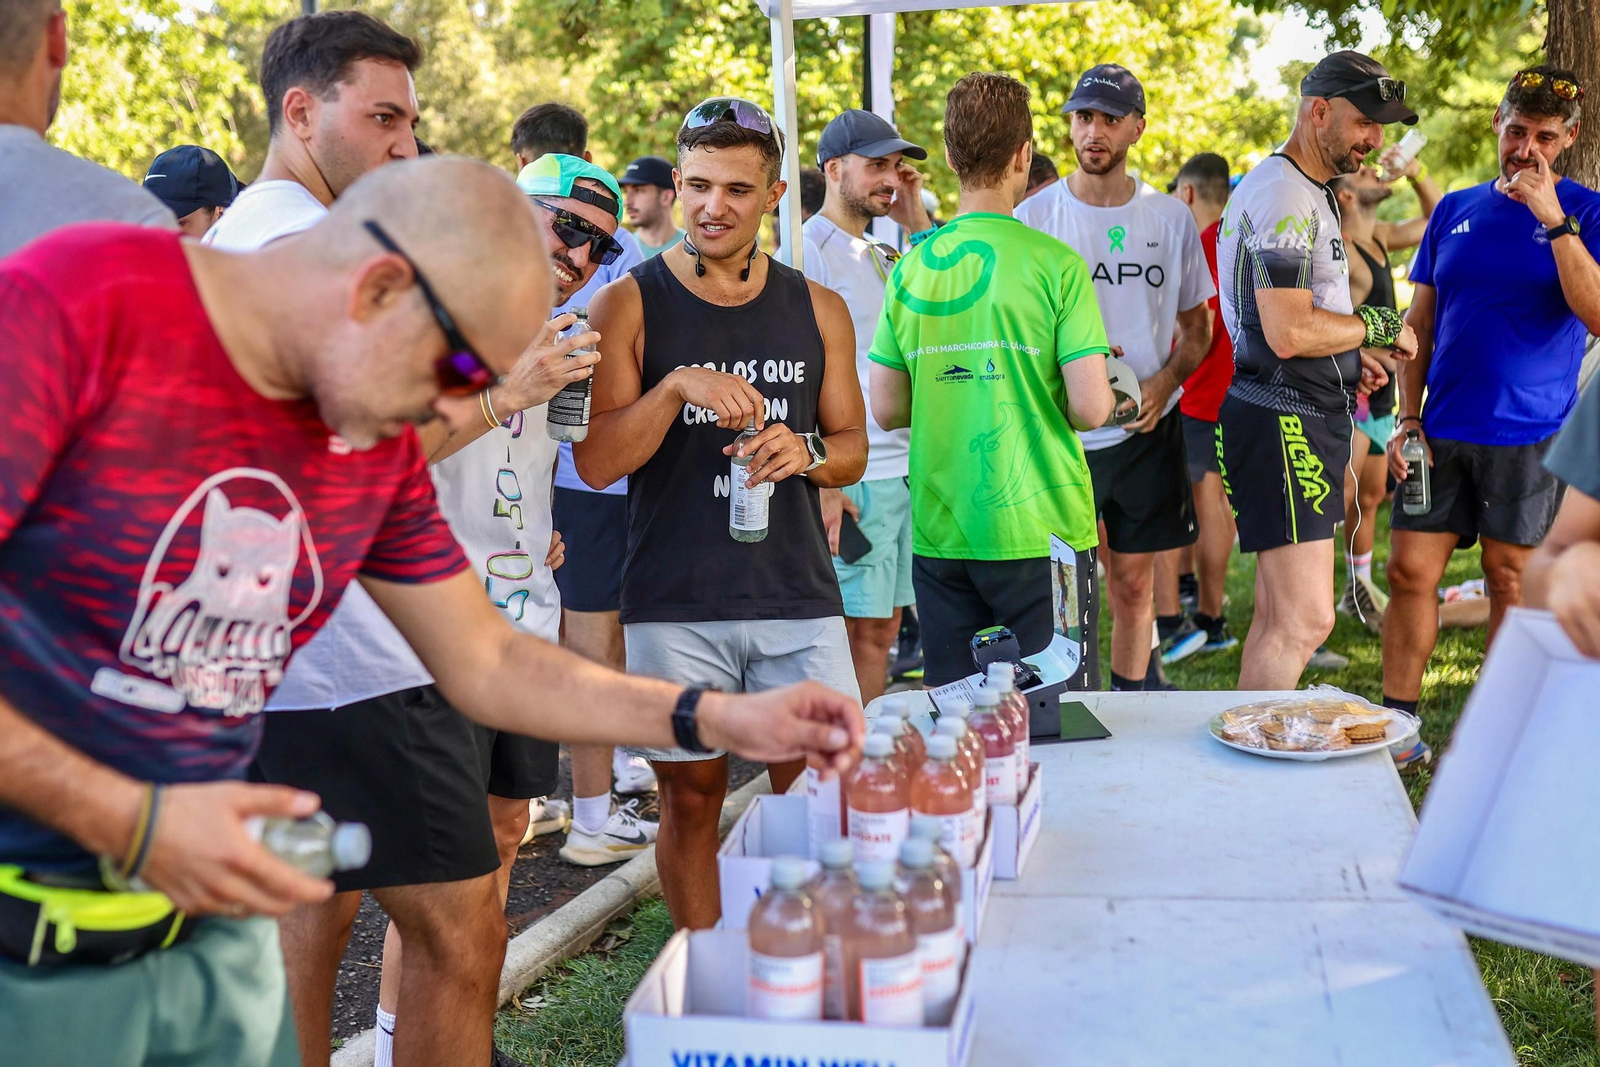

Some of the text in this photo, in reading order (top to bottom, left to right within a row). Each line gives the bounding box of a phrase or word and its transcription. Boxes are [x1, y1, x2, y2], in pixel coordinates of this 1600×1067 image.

[926, 345, 939, 355] EN
[1000, 339, 1009, 349] EL
[762, 359, 806, 384] QUE
[1279, 413, 1323, 501] BICHA
